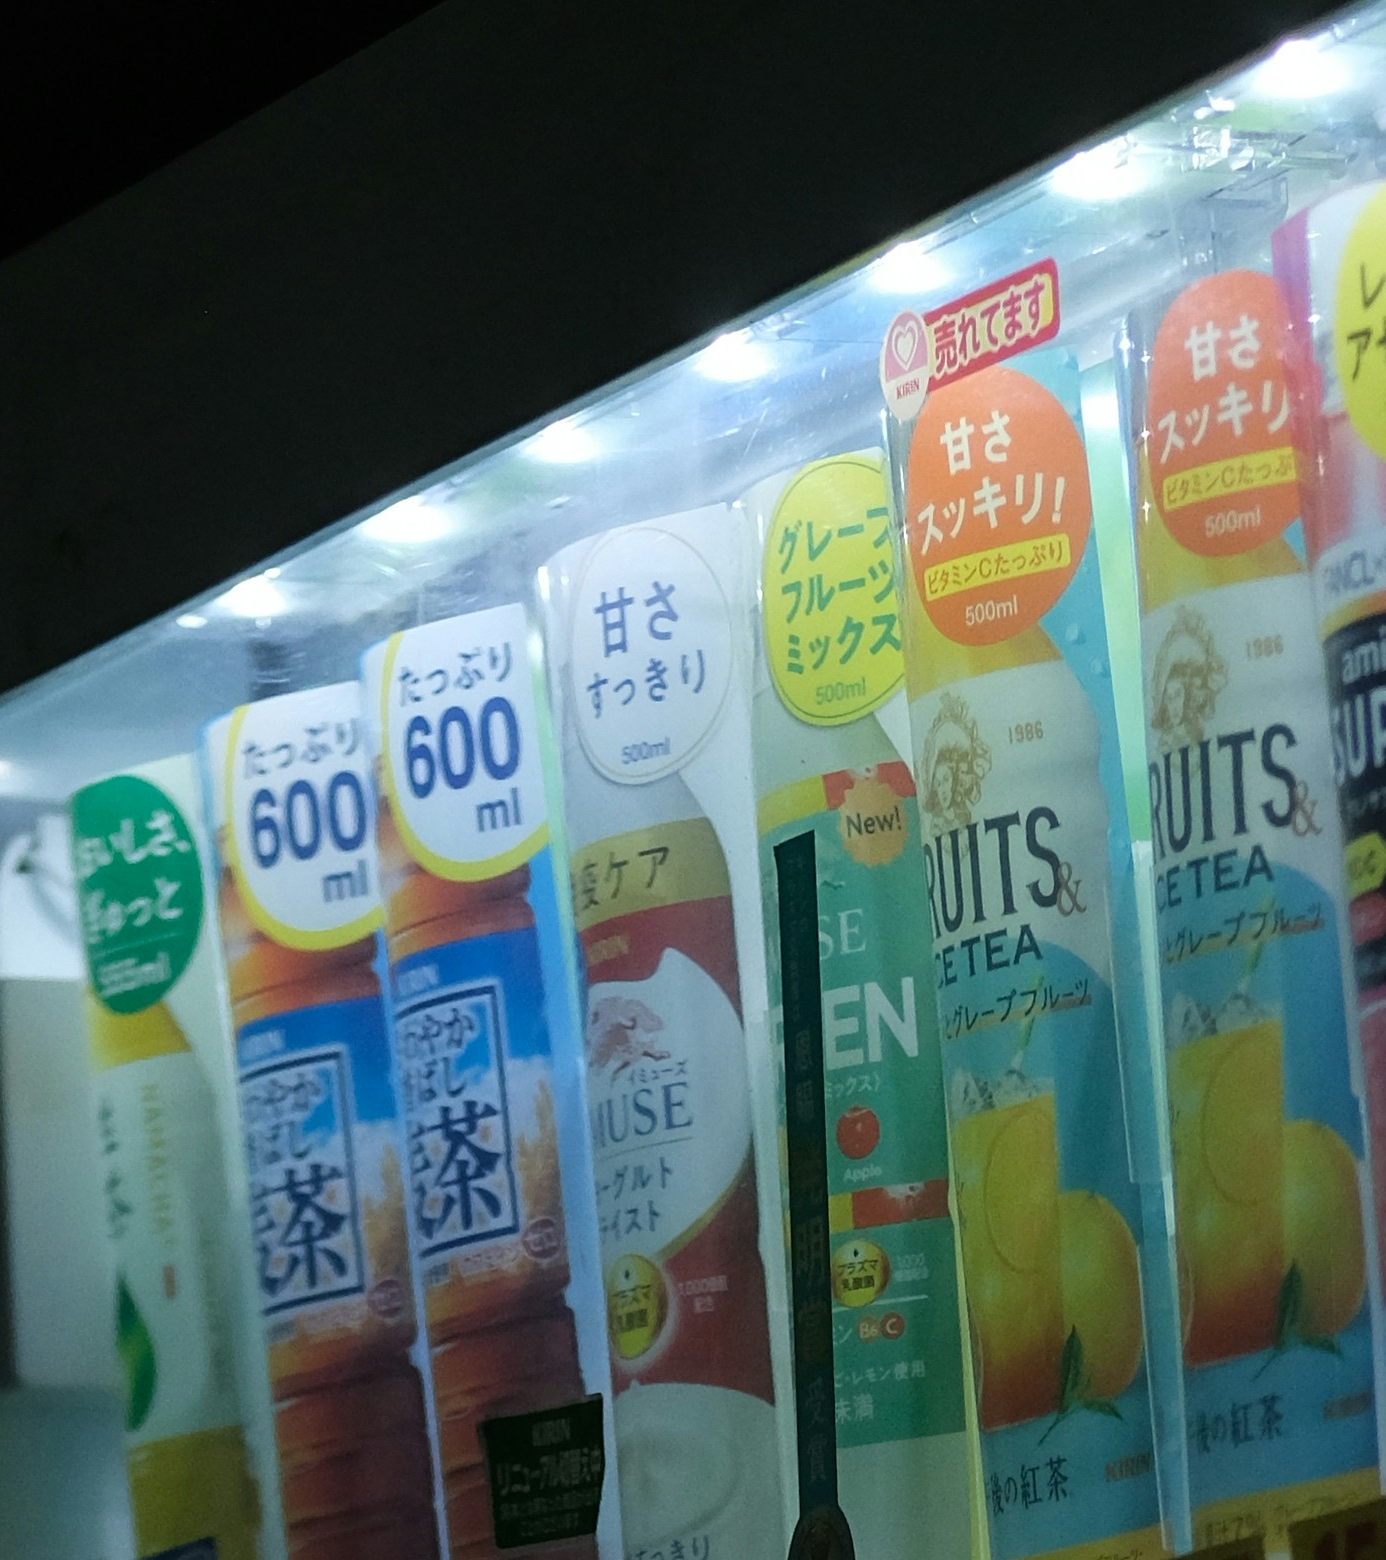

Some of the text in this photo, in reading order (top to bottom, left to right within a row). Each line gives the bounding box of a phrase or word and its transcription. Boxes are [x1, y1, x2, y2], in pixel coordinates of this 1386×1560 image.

[933, 278, 1047, 373] 売れてます
[1184, 315, 1262, 383] 甘さ
[896, 378, 921, 401] KIRIN
[940, 410, 1013, 477] 甘さ
[1157, 380, 1291, 465] スッキリ
[918, 472, 1067, 557] スッキリ!
[1205, 505, 1263, 538] 500ml
[782, 559, 896, 625] フルーツ
[926, 540, 1066, 595] ビタミンCたっぷり
[594, 581, 680, 658] 甘さ
[965, 596, 1019, 627] 500ml
[397, 641, 512, 706] たっぷり
[784, 610, 904, 677] ミックス
[587, 649, 707, 719] すっきり
[814, 676, 867, 705] 500ml
[240, 722, 363, 779] たっぷり
[405, 696, 523, 799] 600
[620, 736, 671, 765] 500ml
[1007, 721, 1045, 745] 1986
[249, 769, 367, 870] 600
[475, 788, 523, 834] ml
[844, 806, 903, 842] New!
[321, 861, 369, 905] ml
[843, 1163, 883, 1184] Apple
